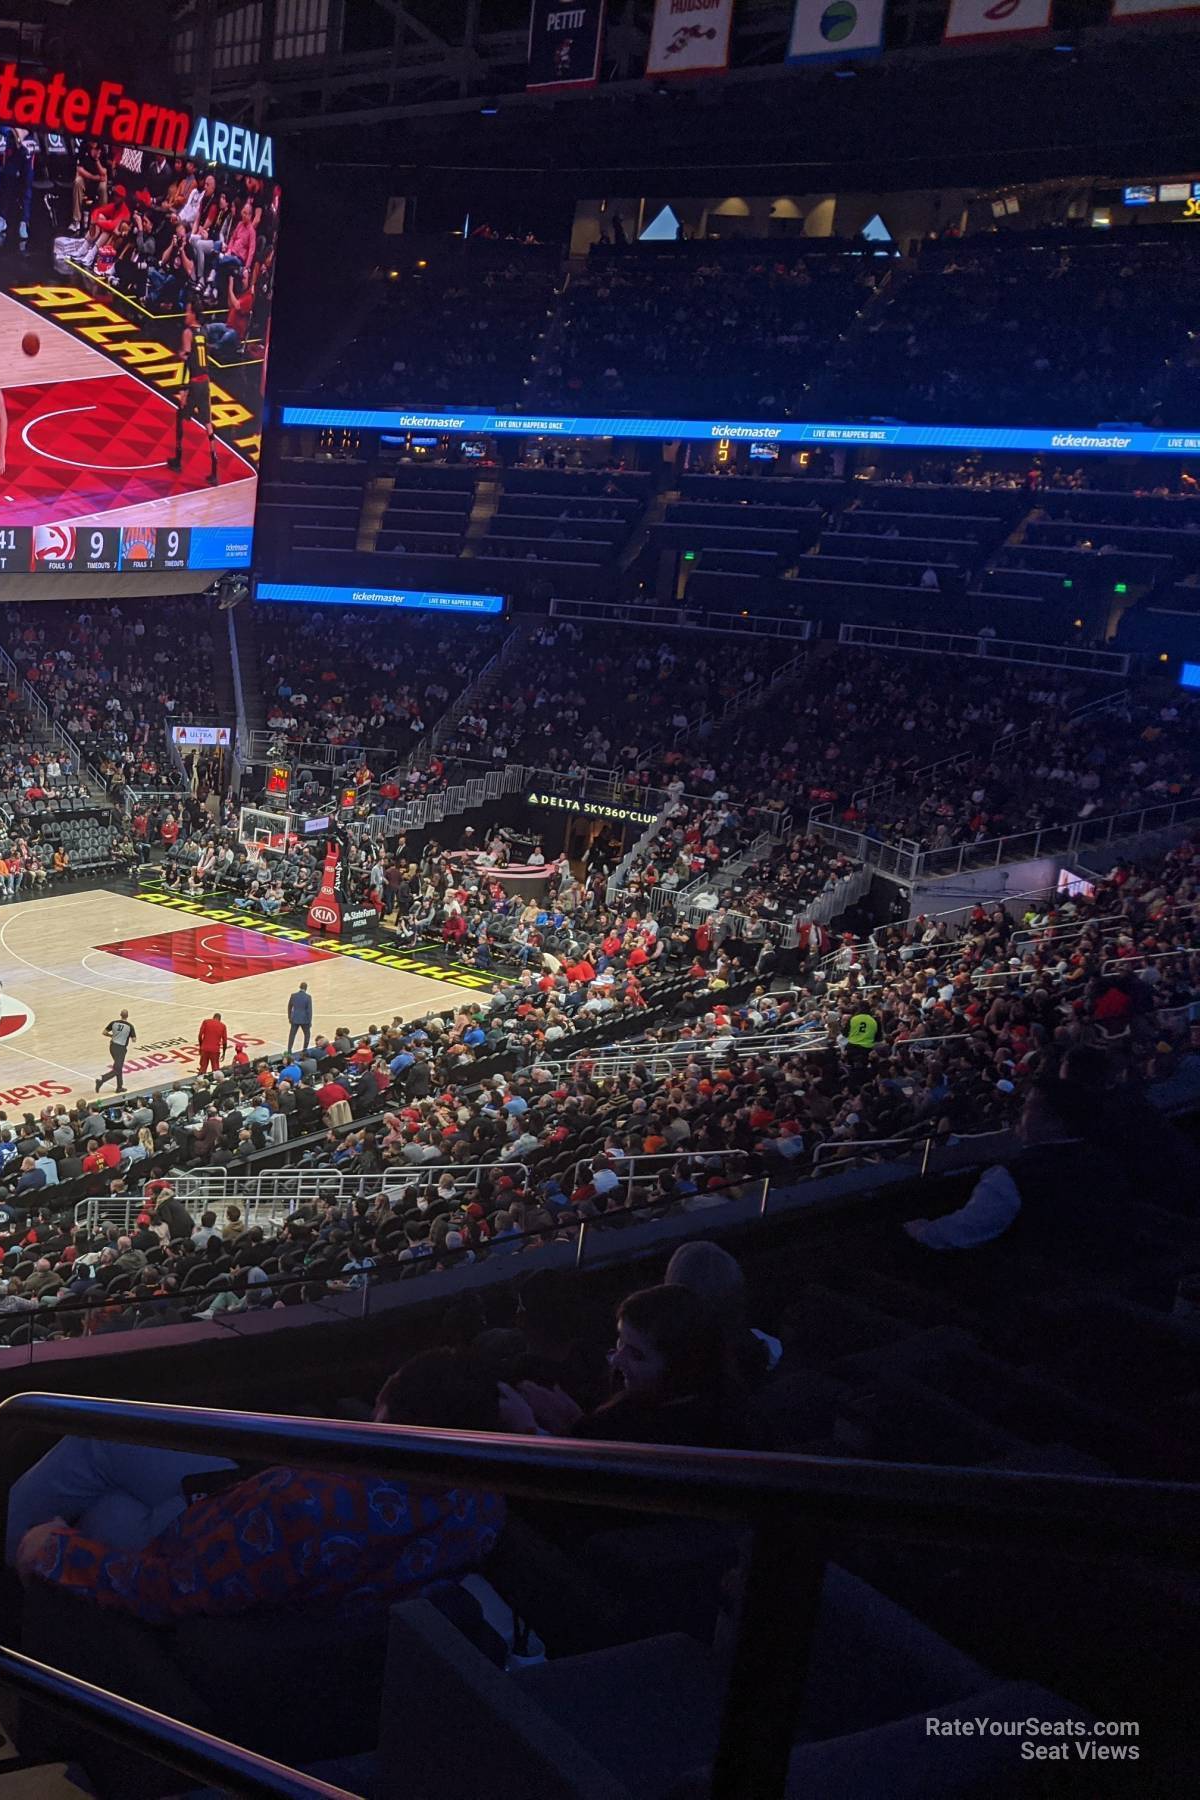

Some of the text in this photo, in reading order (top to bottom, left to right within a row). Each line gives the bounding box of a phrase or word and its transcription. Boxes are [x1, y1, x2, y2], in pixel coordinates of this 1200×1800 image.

[546, 9, 586, 31] PETTIT
[190, 116, 273, 178] ARENA
[399, 414, 465, 428] ticketmaster
[495, 420, 508, 428] LIVE
[522, 421, 547, 429] HAPPENS
[711, 424, 782, 438] ticketmaster
[813, 429, 826, 438] LIVE
[827, 430, 841, 438] ONLY
[842, 430, 869, 439] HAPPENS
[1051, 433, 1132, 448] ticketmaster
[1167, 438, 1183, 448] LIVE
[90, 531, 104, 558] 9
[167, 531, 179, 557] 9
[49, 562, 73, 570] FOULS 0
[87, 562, 117, 570] TIMEOUTS 7
[352, 591, 405, 603] ticketmaster
[541, 795, 580, 811] DELTA
[137, 893, 311, 940] ATLANTA
[315, 909, 333, 923] KIA
[353, 919, 367, 928] ARENA
[313, 938, 492, 989] HAWKS
[859, 1022, 867, 1033] 2
